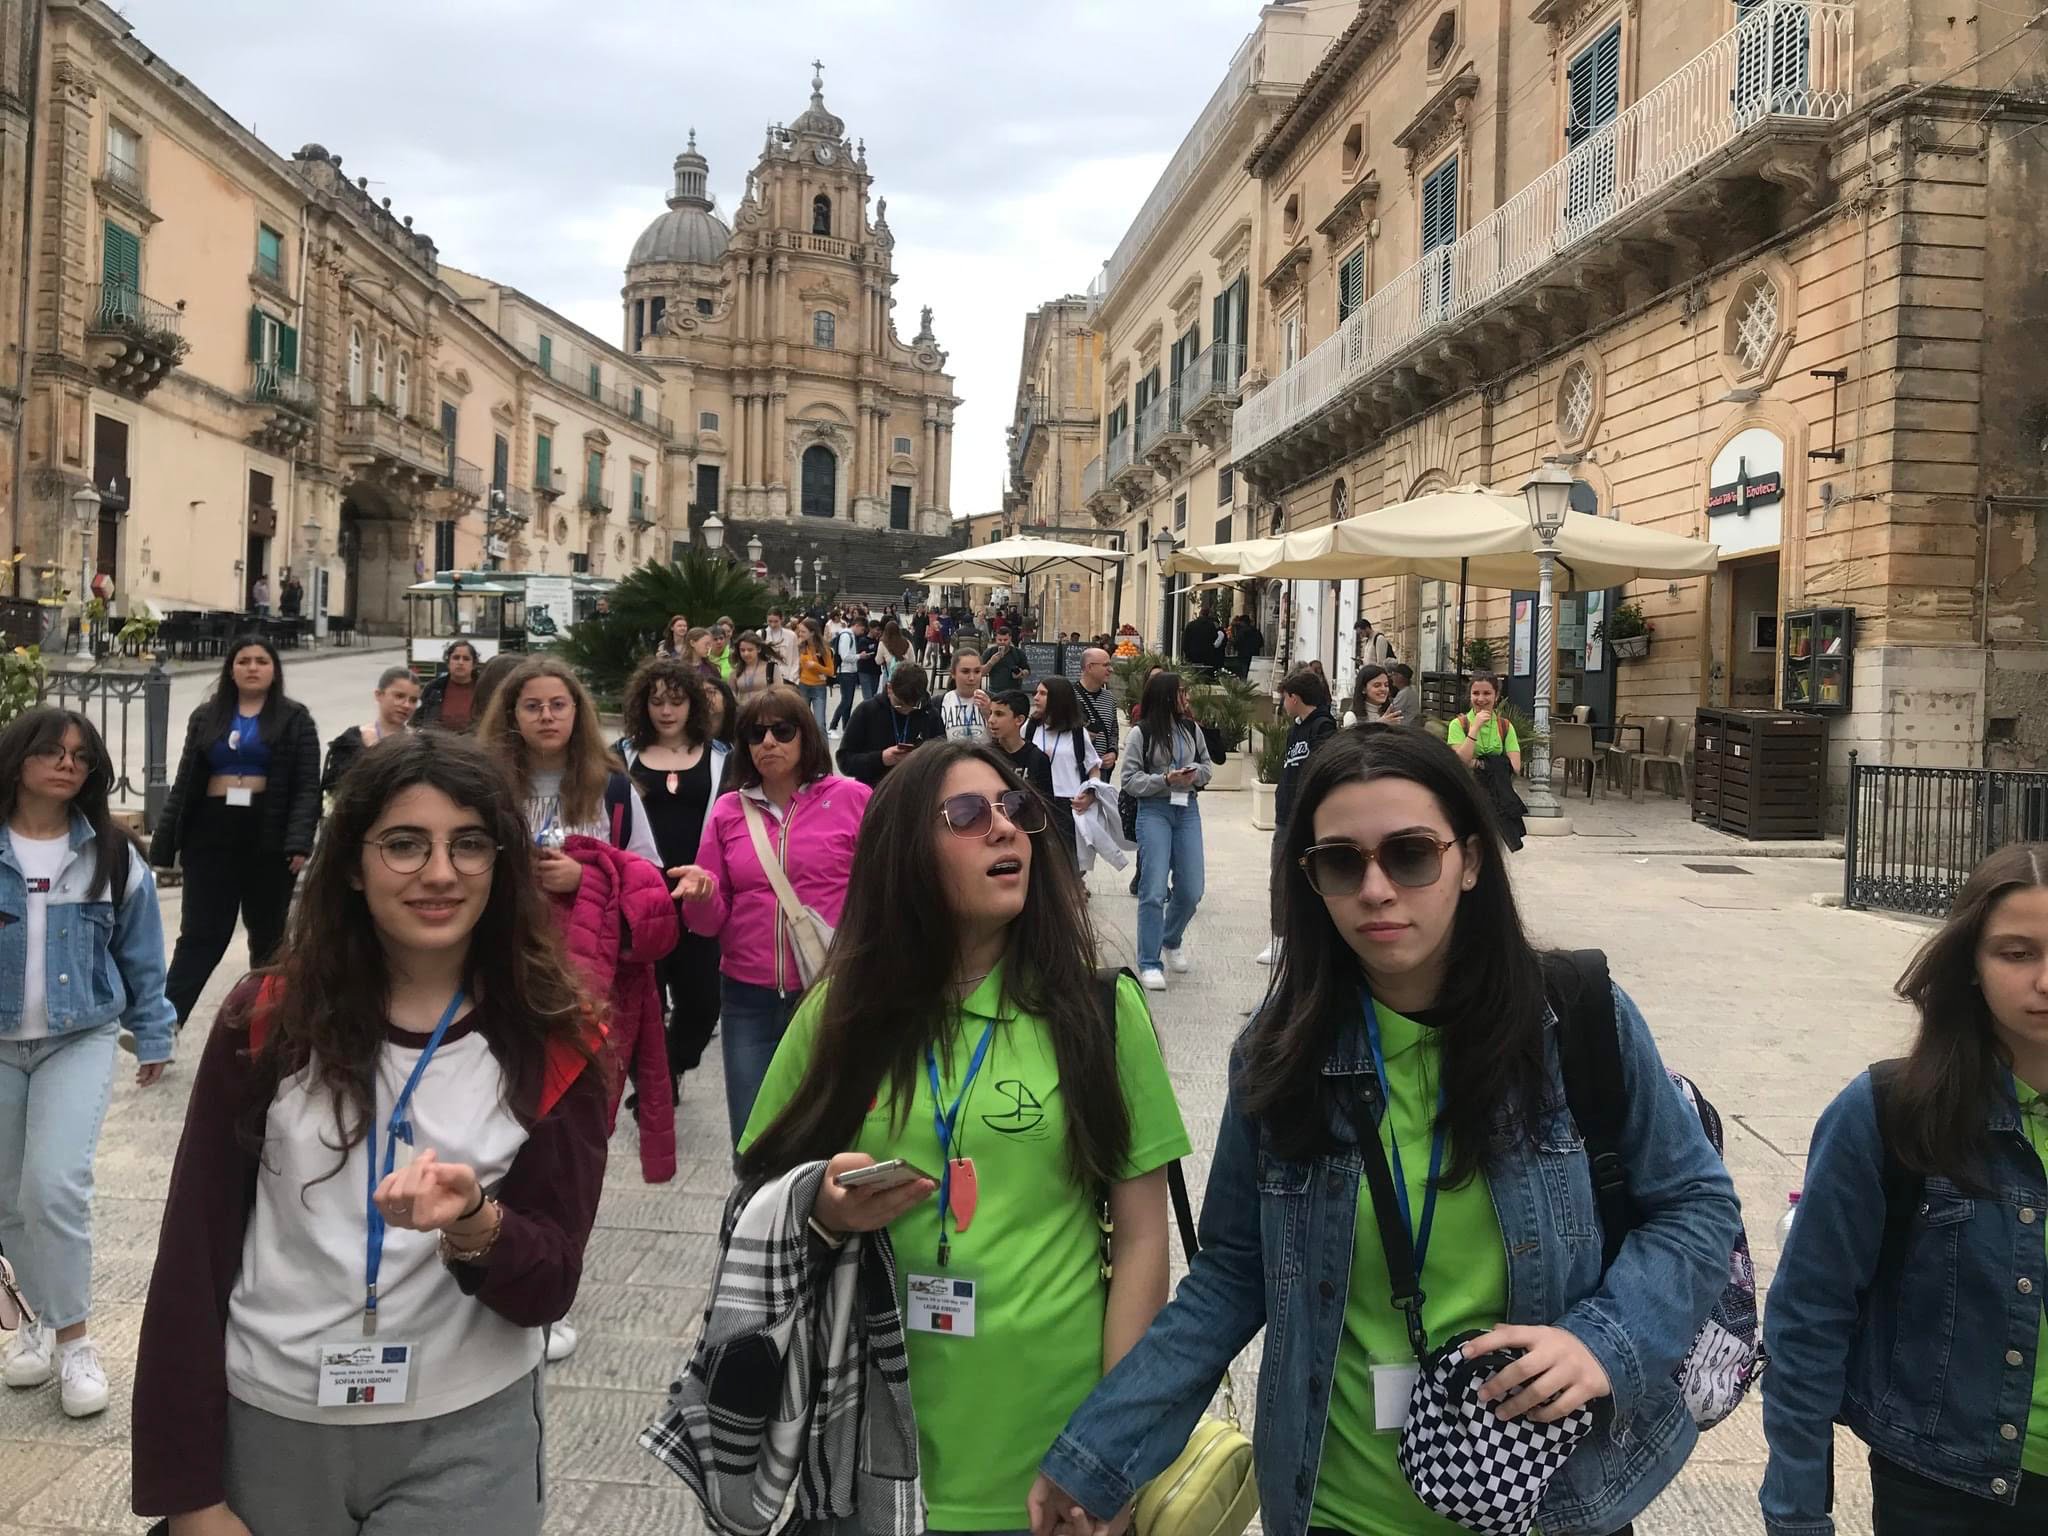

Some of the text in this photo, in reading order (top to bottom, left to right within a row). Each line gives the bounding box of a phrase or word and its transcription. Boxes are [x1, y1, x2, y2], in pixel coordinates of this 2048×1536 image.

[1746, 483, 1777, 498] Enoteca
[335, 1376, 392, 1386] SOFIA FELIGIONI
